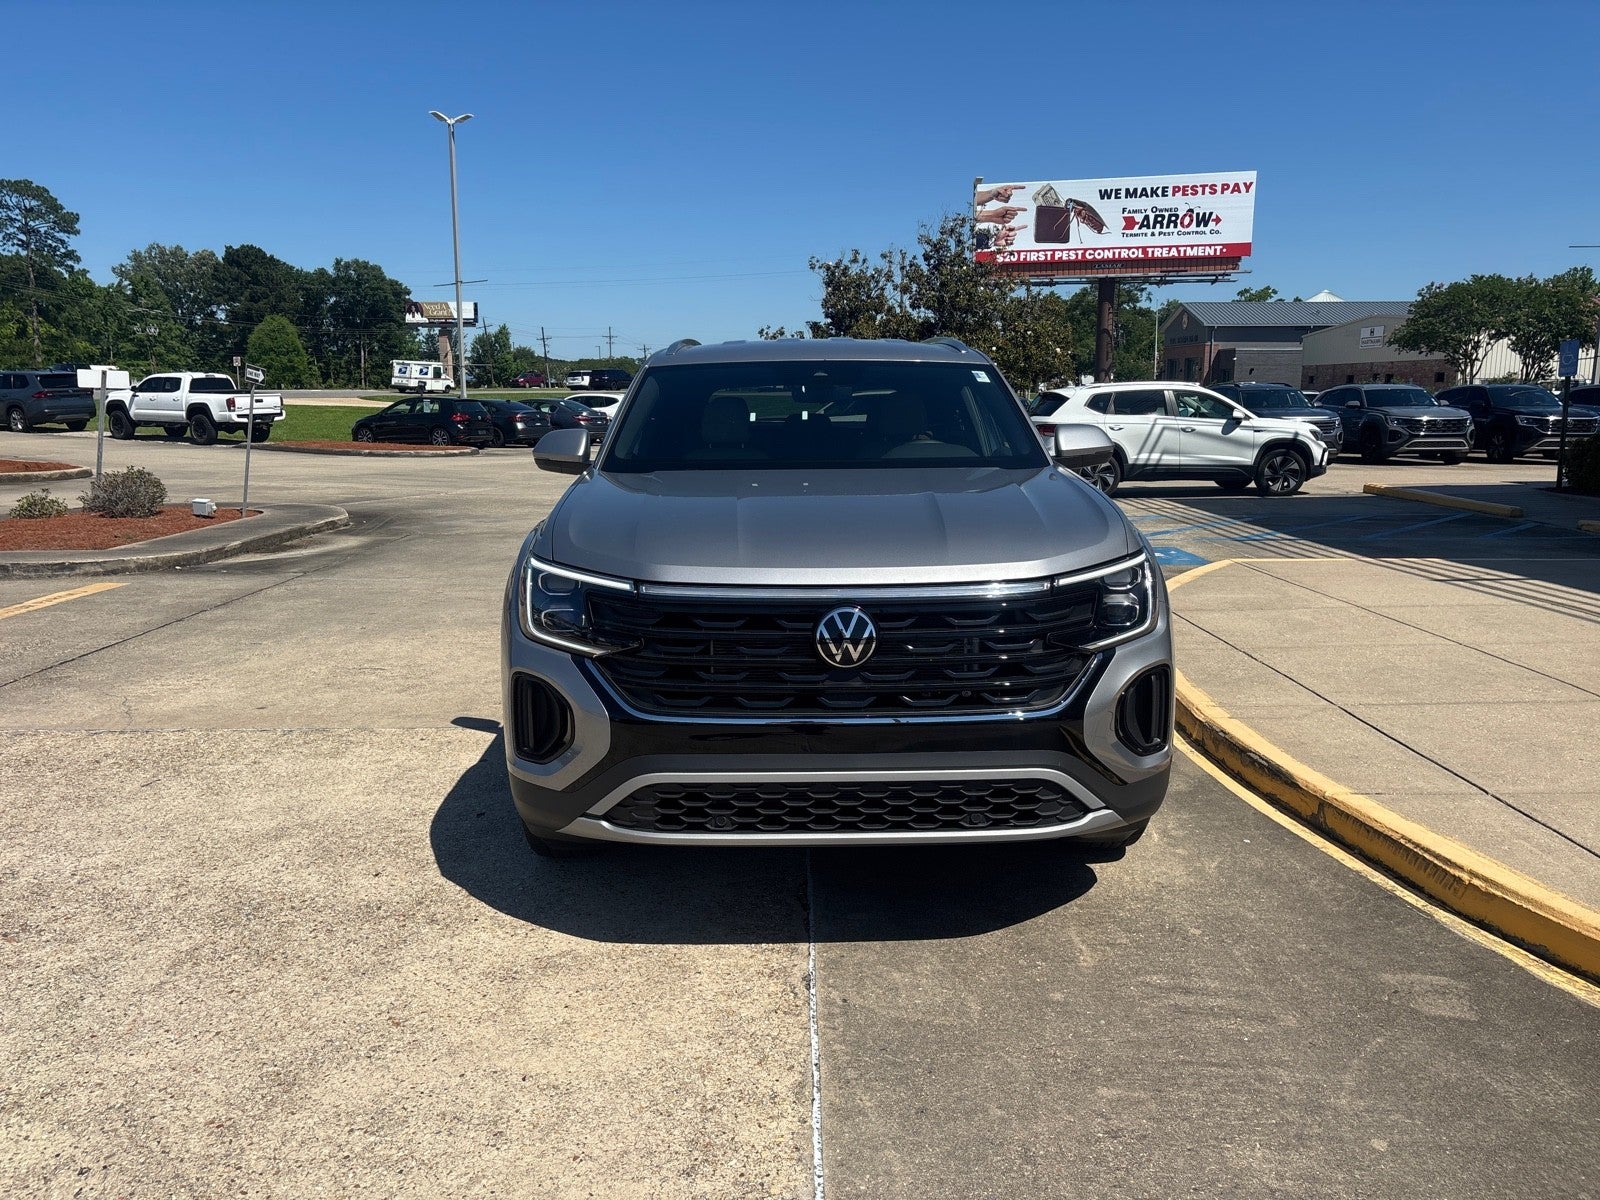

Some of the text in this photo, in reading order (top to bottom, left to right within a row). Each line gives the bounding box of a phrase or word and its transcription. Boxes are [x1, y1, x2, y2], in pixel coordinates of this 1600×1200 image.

[1098, 181, 1254, 200] WE MAKE PESTS PAY
[1121, 206, 1179, 215] FAMILY OWNED
[1138, 211, 1214, 230] ARROW
[1019, 250, 1053, 262] FIRST
[1054, 249, 1083, 261] PEST
[1085, 247, 1145, 260] CONTROL
